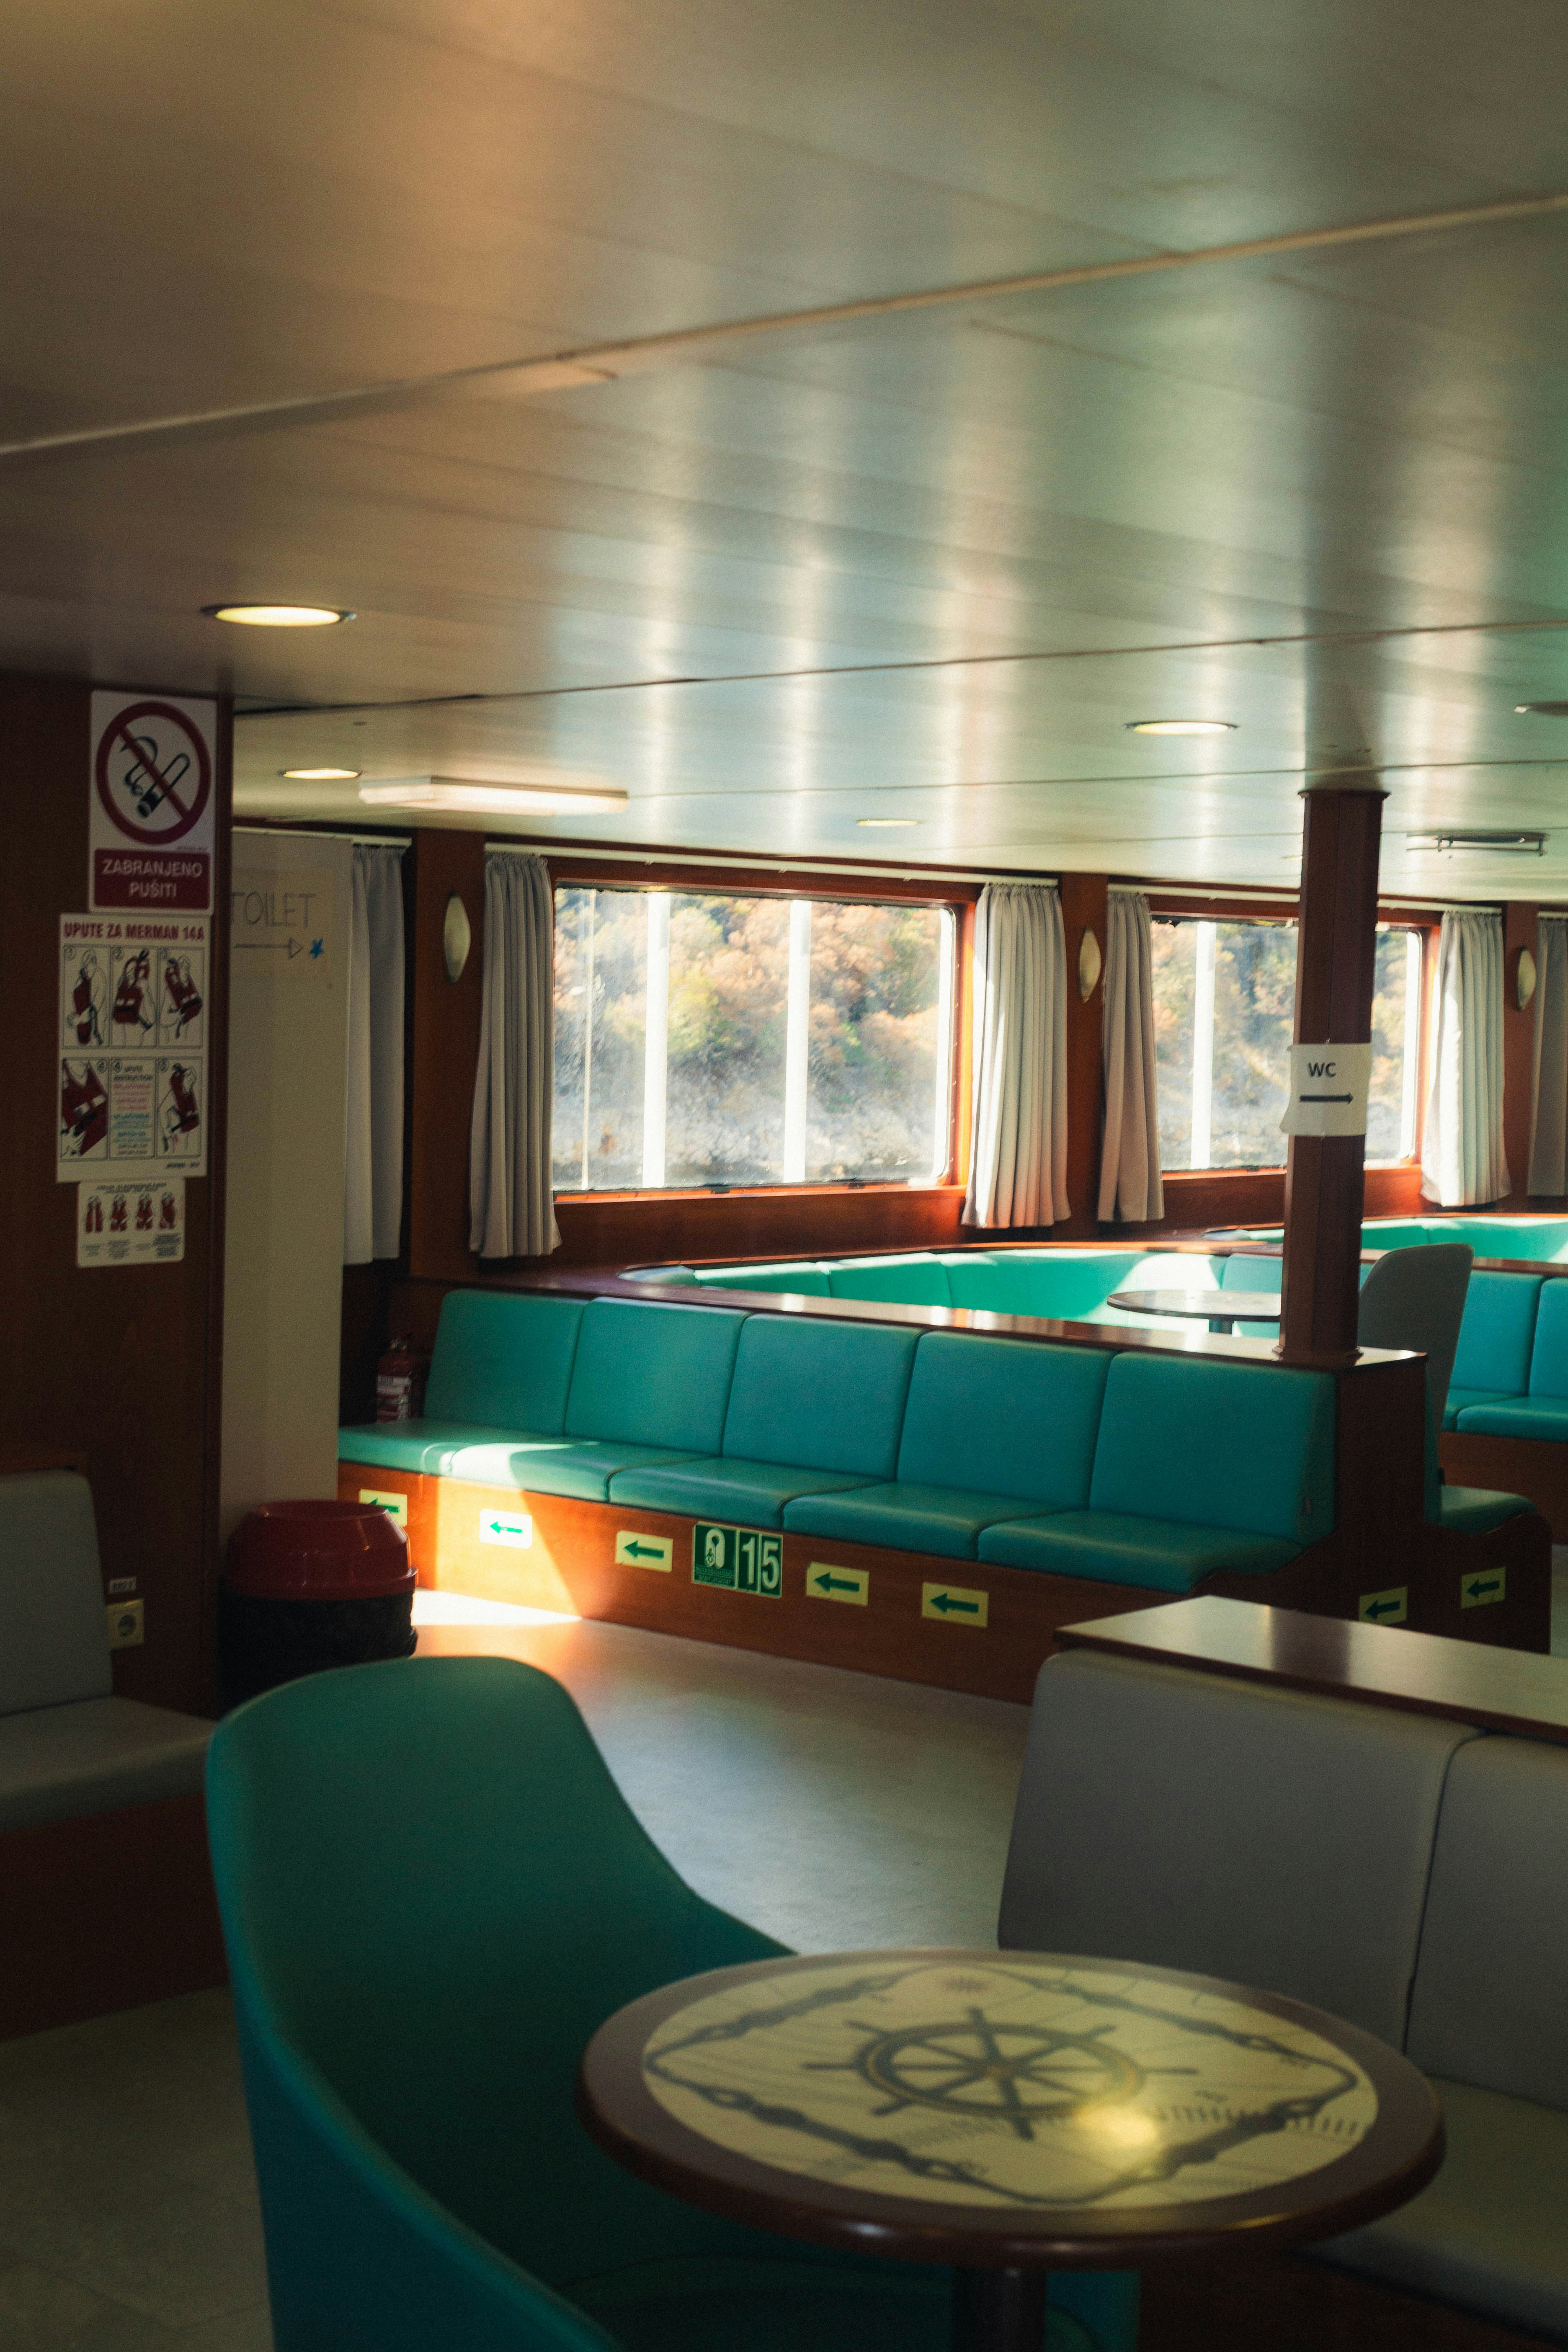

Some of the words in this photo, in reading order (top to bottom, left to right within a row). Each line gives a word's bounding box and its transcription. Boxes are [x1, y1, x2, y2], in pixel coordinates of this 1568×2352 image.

[102, 859, 203, 878] ZABRANJENO
[129, 878, 176, 898] PUŠITI
[230, 891, 316, 928] TOILET
[64, 922, 103, 938] UPUTE
[106, 923, 122, 939] ZA
[125, 924, 179, 940] MERMAN
[183, 926, 205, 942] 14A
[1308, 1062, 1336, 1078] WC
[741, 1537, 780, 1589] 15
